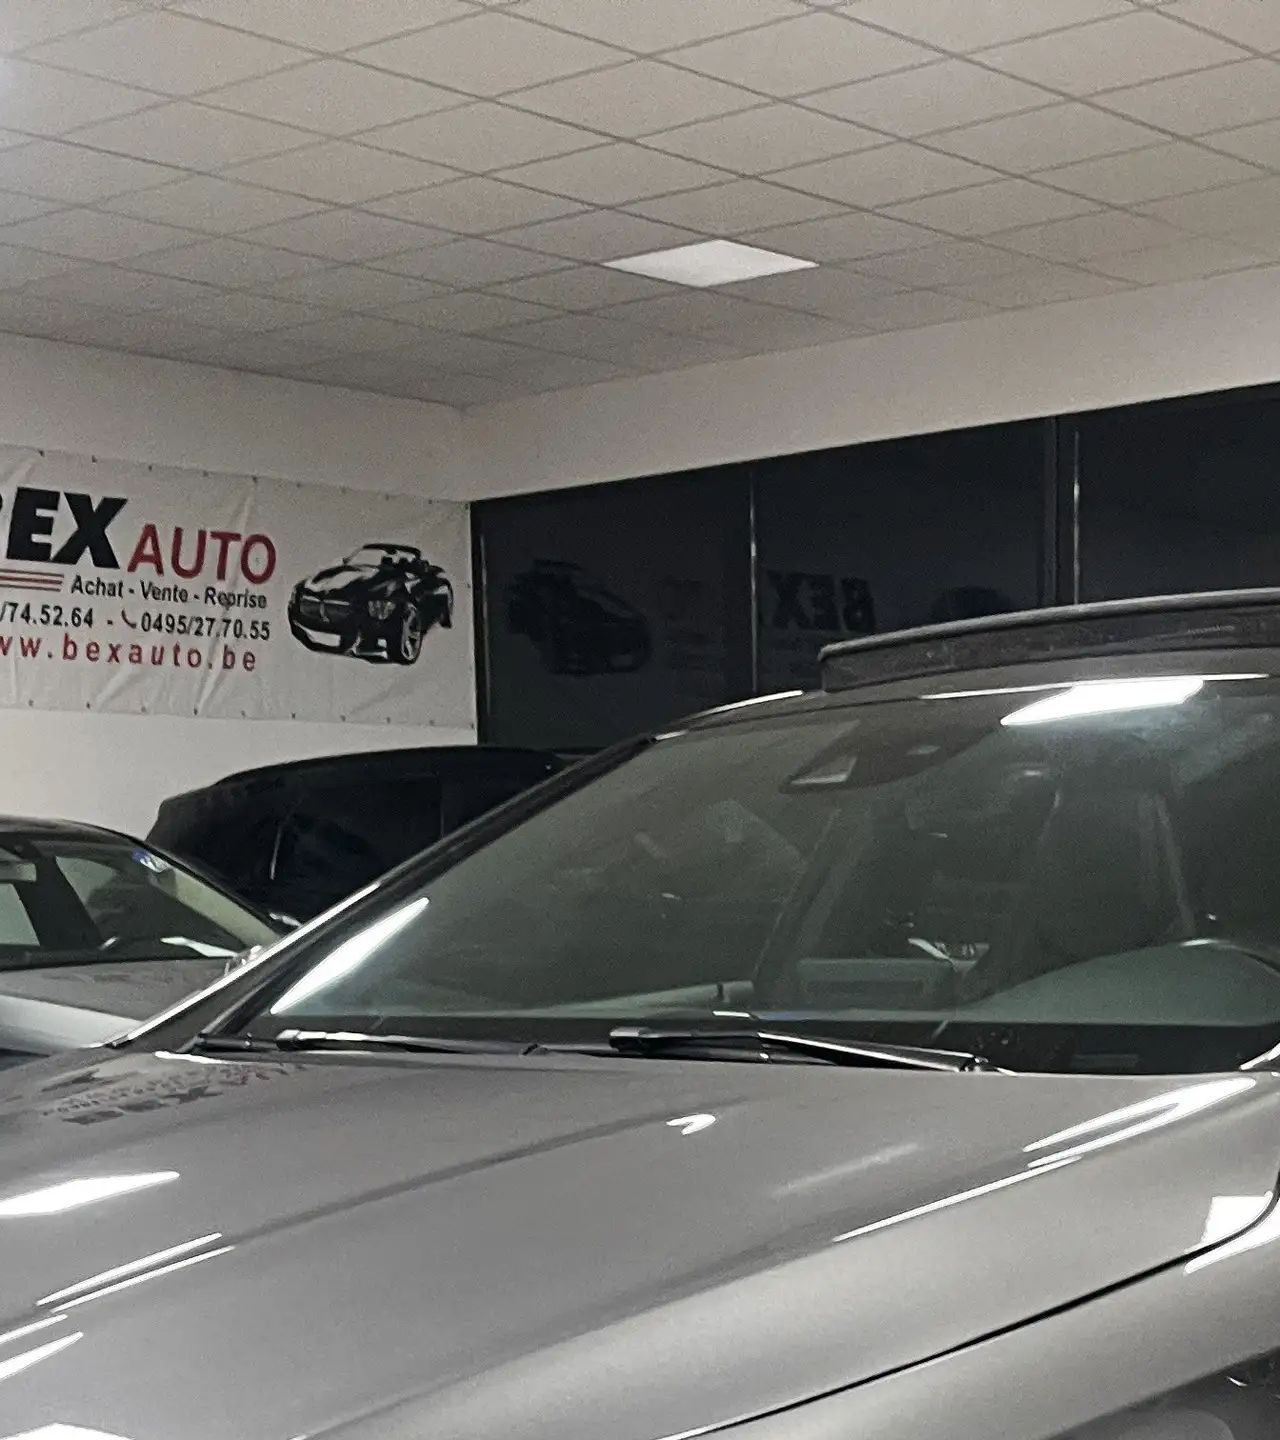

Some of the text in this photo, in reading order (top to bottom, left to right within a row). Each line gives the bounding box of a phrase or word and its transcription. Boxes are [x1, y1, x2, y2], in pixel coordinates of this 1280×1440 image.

[127, 523, 277, 585] AUTO
[71, 575, 124, 598] Achat
[140, 580, 189, 603] Vente
[204, 586, 268, 610] Reprise
[140, 612, 271, 640] 0495/27.70.55
